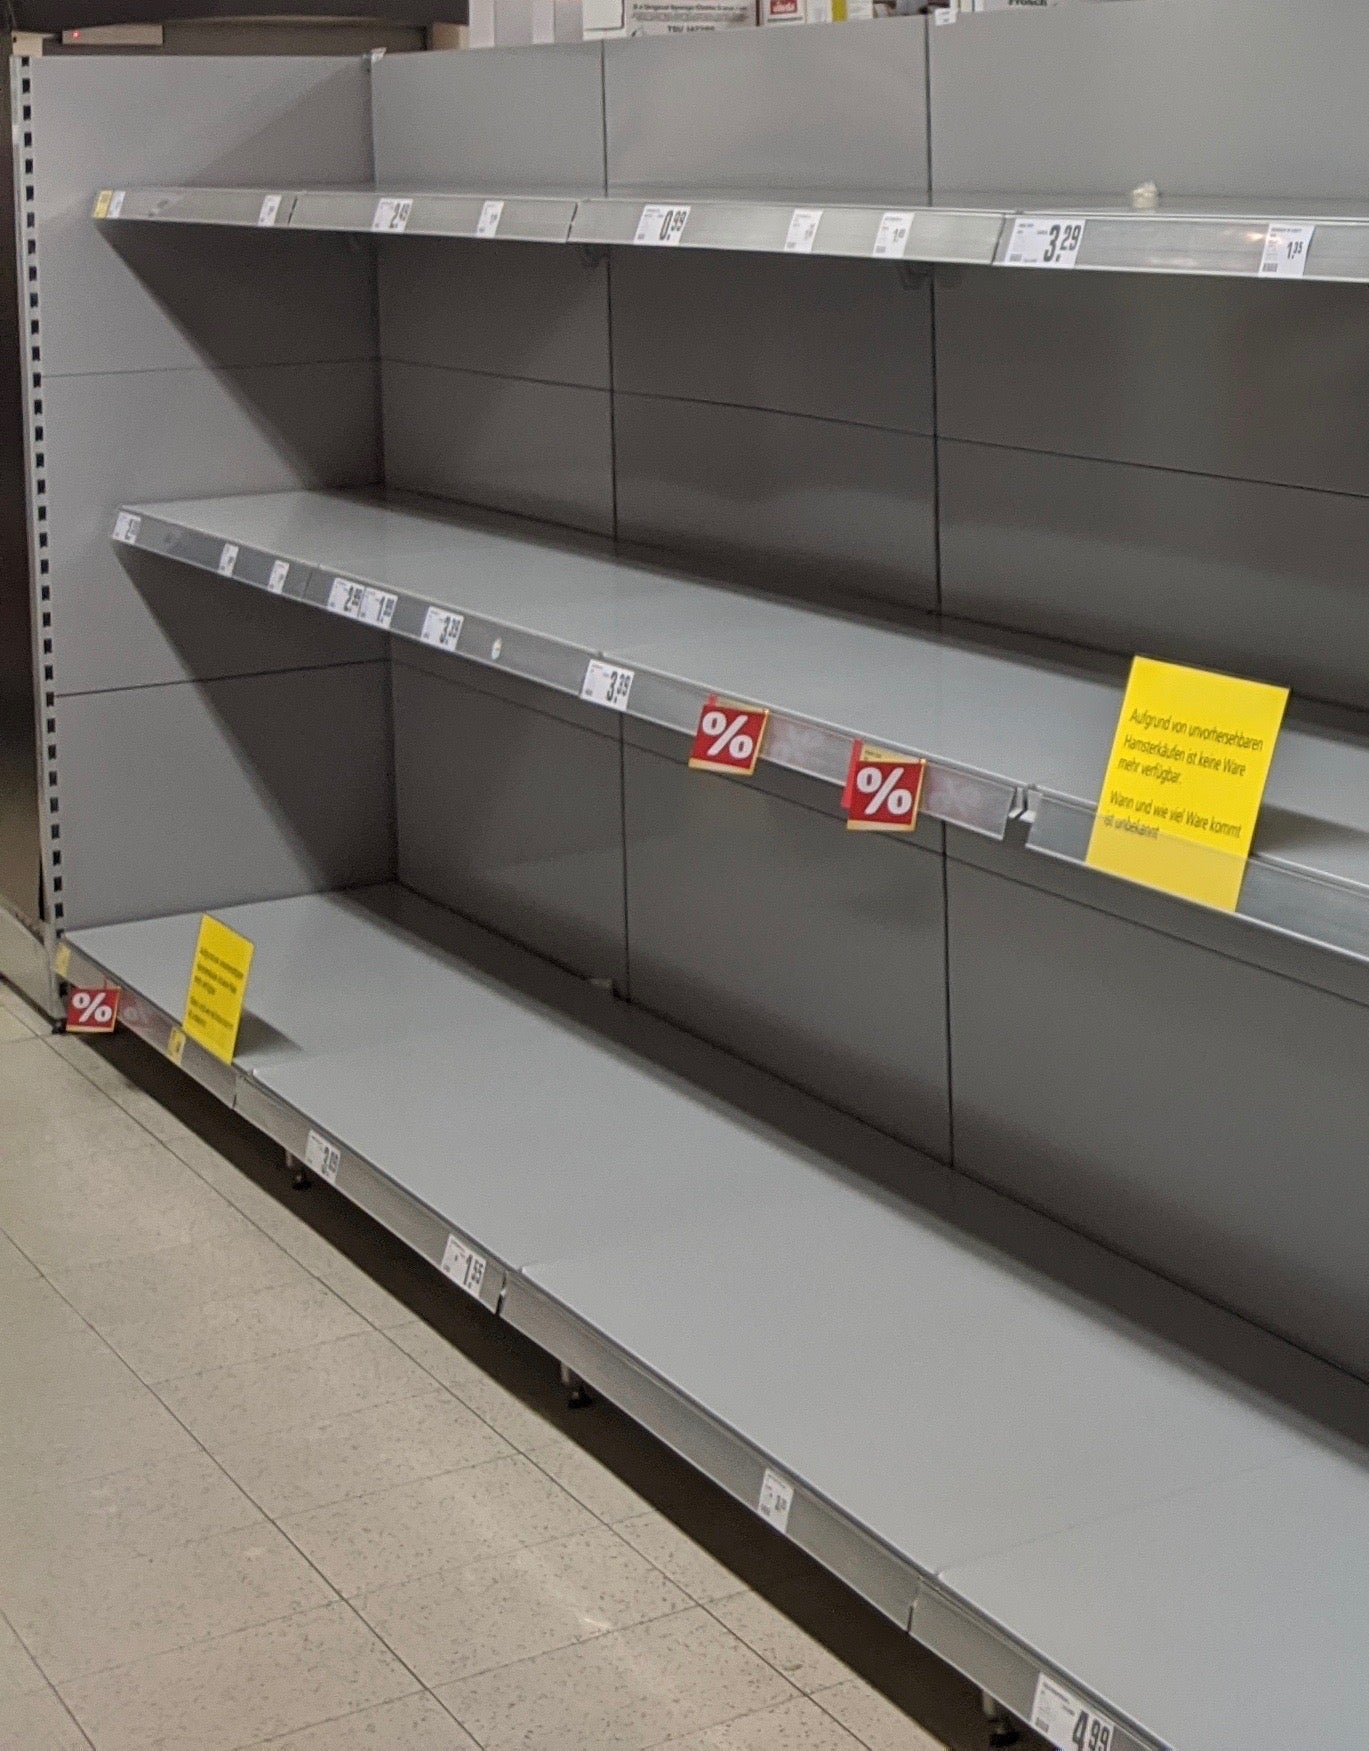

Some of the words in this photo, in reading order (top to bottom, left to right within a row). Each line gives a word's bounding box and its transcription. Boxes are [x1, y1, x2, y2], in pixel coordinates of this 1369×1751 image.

[659, 210, 687, 241] 0.99
[1043, 224, 1082, 263] 3.29
[1129, 708, 1172, 730] Aufgrund
[1171, 721, 1188, 734] von
[1188, 724, 1263, 752] unvorhersehbaren
[1117, 757, 1140, 773] mehr
[1123, 734, 1185, 761] Hamsterkäufen
[1186, 748, 1198, 765] ist
[1198, 751, 1222, 771] keine
[1223, 757, 1246, 776] Ware
[1110, 790, 1134, 808] Wann
[1135, 800, 1153, 815] und
[1153, 804, 1169, 819] wie
[1169, 807, 1186, 823] viel
[1186, 810, 1209, 830] Ware
[1209, 816, 1242, 838] kommt
[1073, 1711, 1110, 1751] 499
